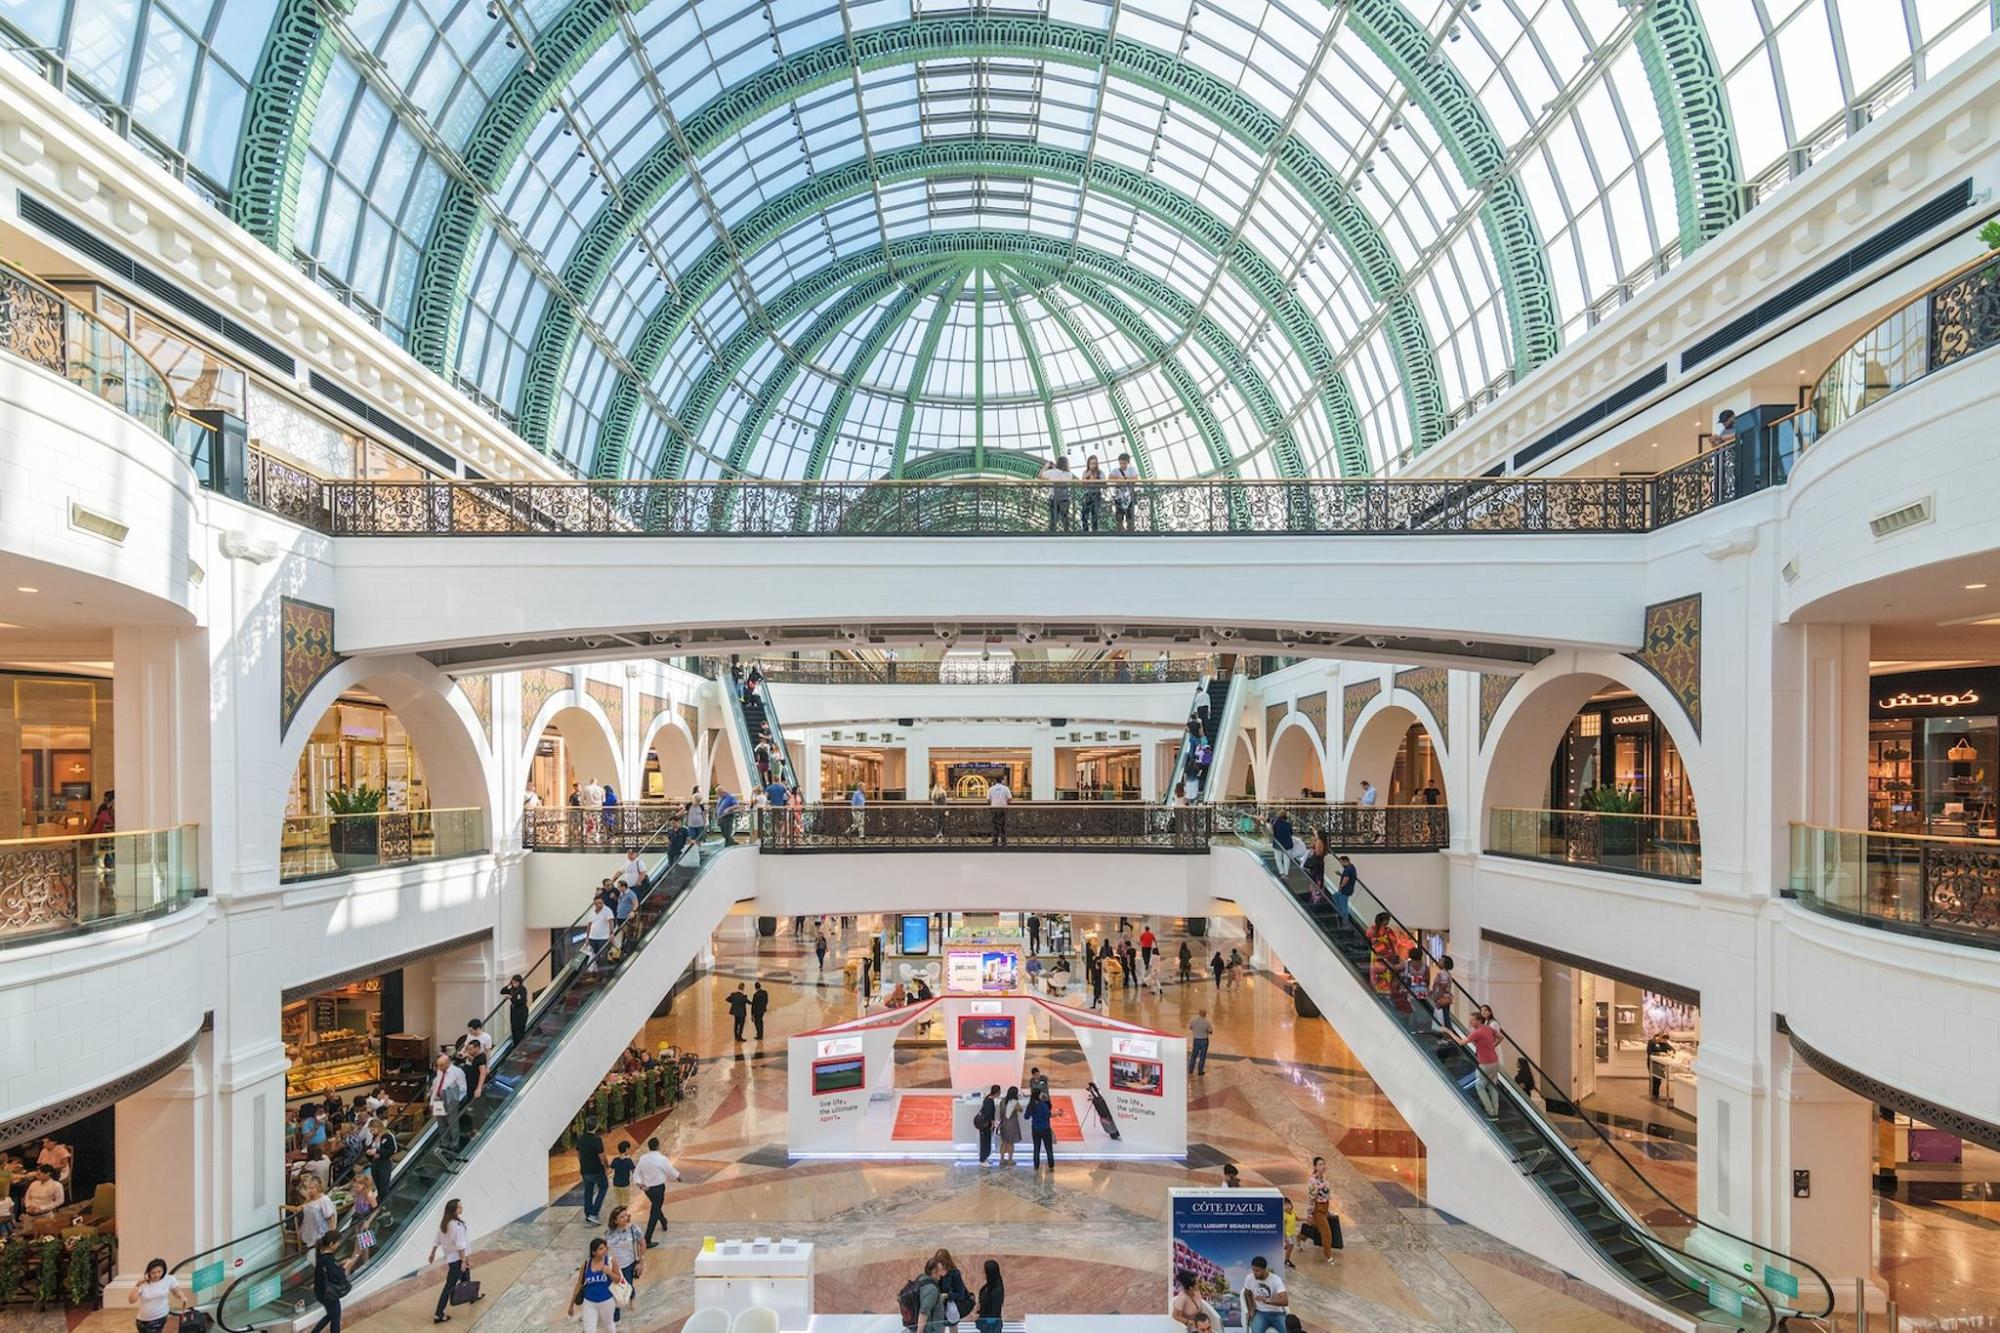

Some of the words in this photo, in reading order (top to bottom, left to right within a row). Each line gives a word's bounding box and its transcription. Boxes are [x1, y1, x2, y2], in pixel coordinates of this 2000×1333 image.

[1878, 689, 1979, 709] كوتش
[1612, 713, 1649, 725] COACH
[831, 1104, 858, 1114] ultimate
[1117, 1104, 1128, 1112] the
[1129, 1106, 1156, 1116] ultimate
[1192, 1200, 1224, 1212] CÔTE
[1225, 1202, 1265, 1212] D'AZUR
